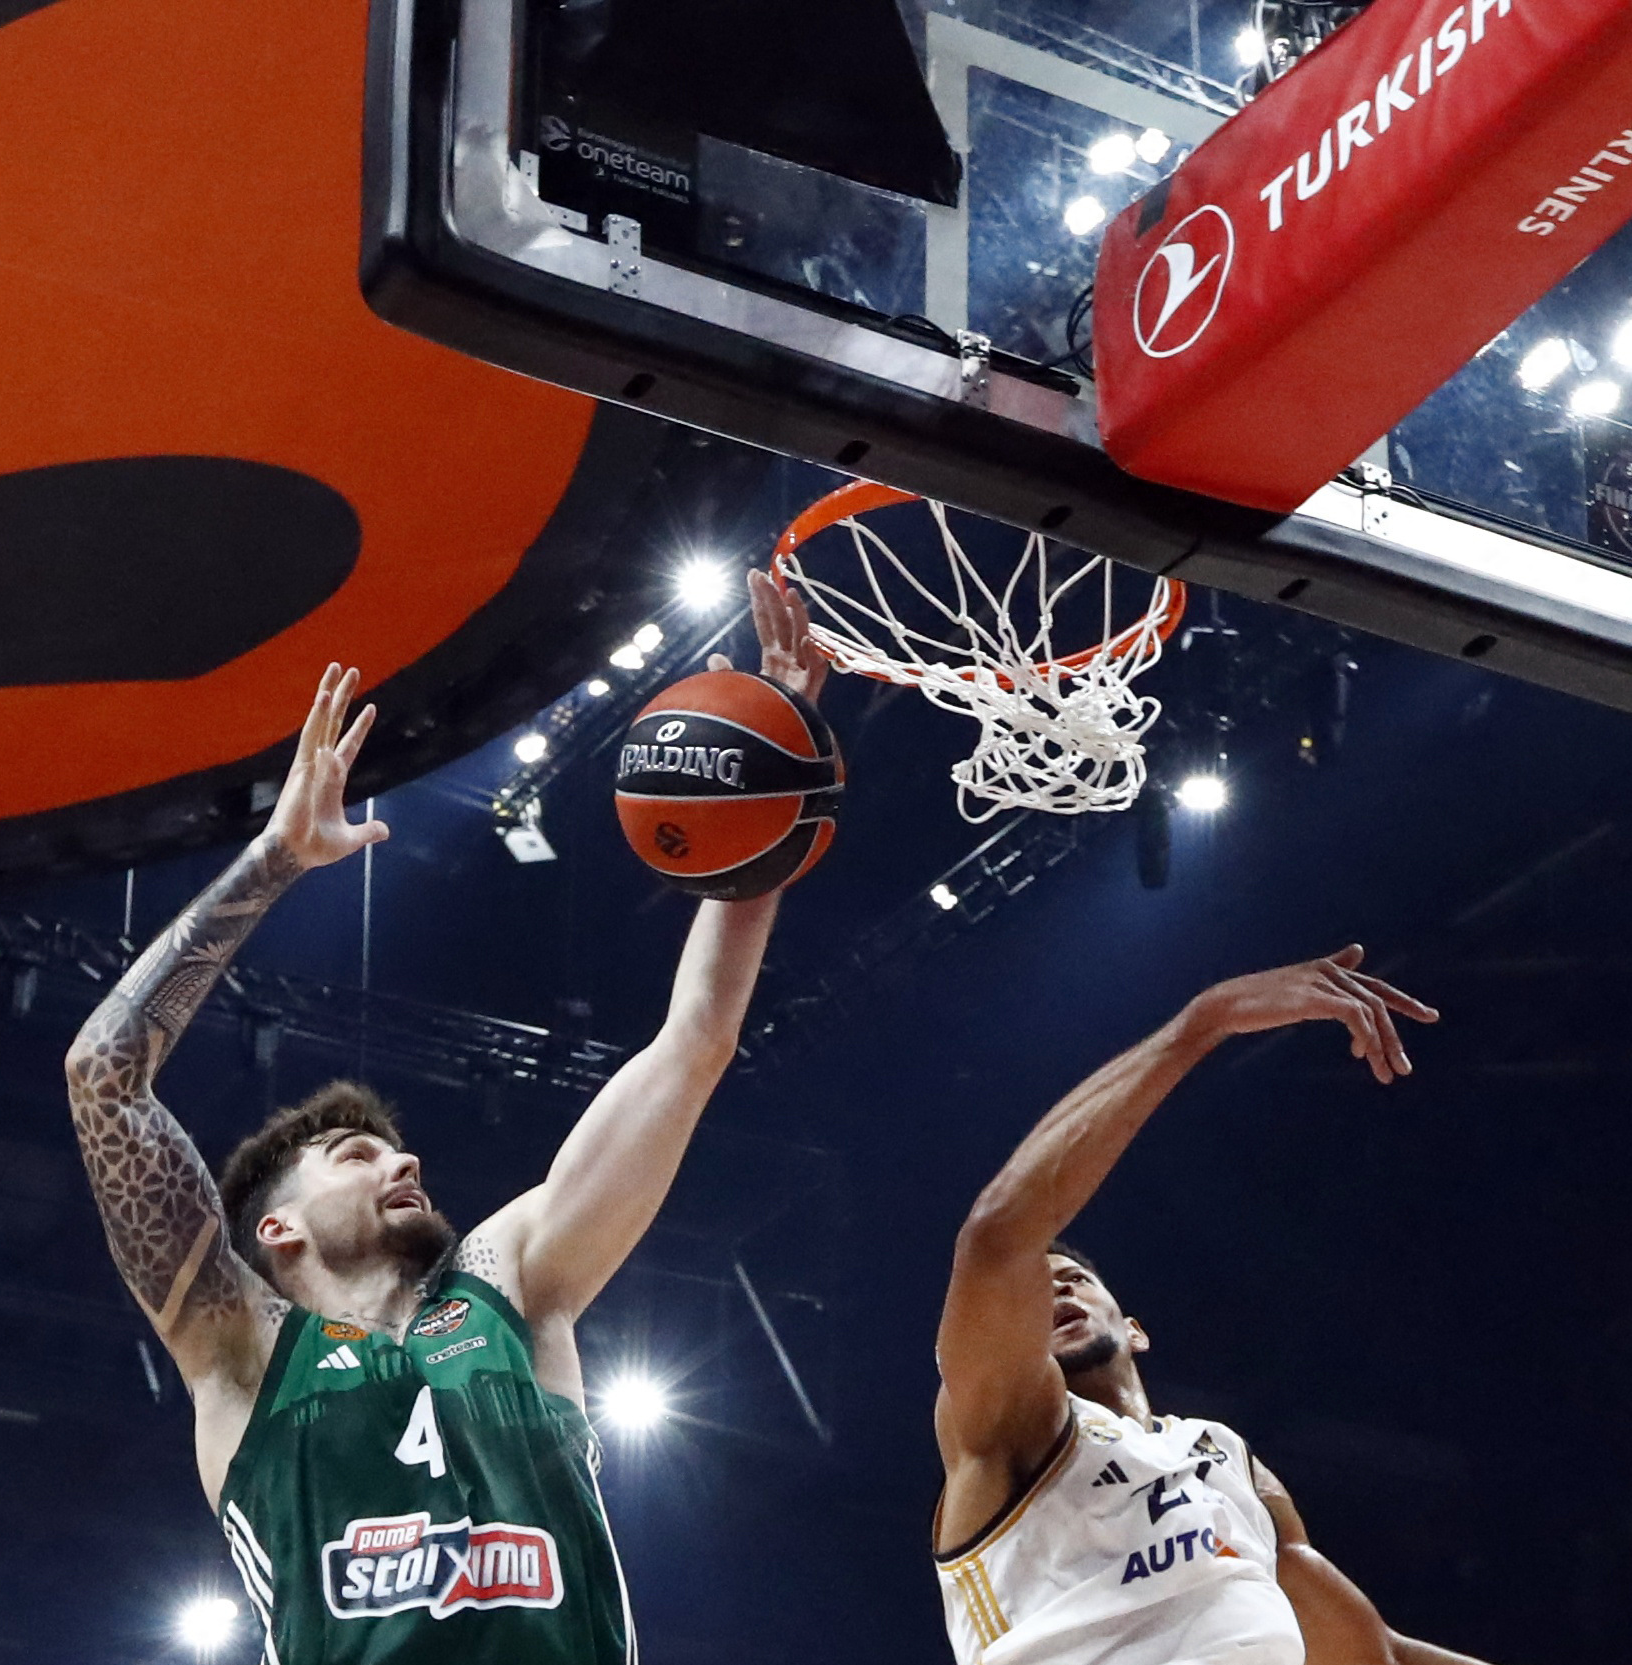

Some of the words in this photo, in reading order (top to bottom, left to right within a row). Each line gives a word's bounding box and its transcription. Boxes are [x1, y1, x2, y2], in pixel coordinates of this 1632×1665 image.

[577, 141, 690, 192] oneteam
[618, 744, 746, 790] SPALDING
[428, 1338, 485, 1363] oneteam
[394, 1386, 446, 1478] 4
[358, 1525, 417, 1551] pame
